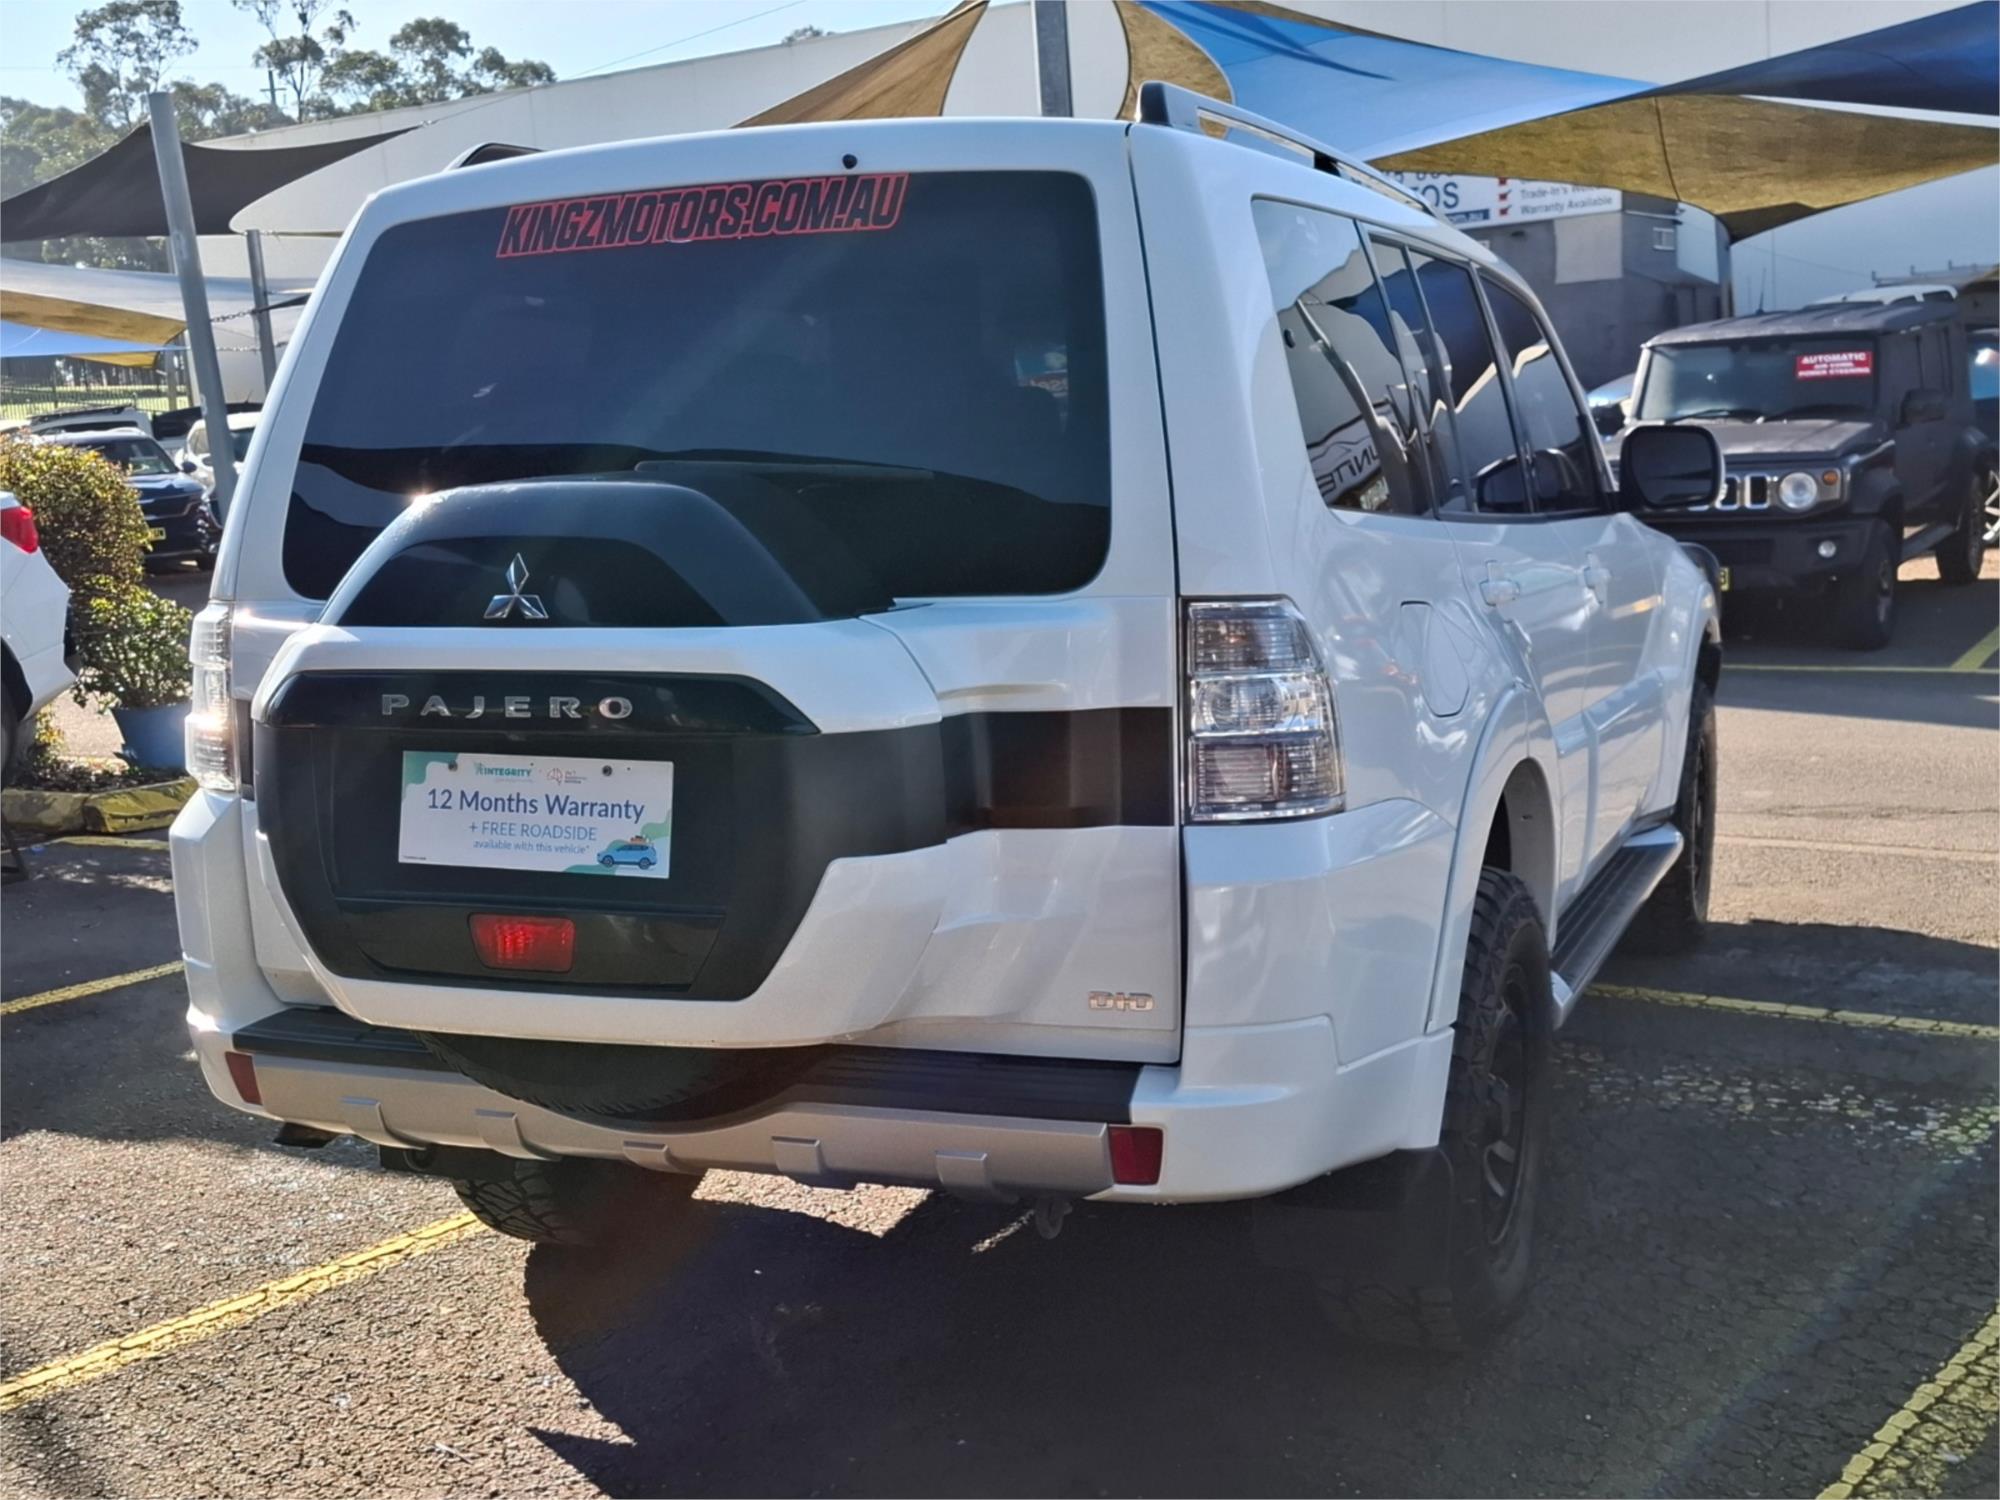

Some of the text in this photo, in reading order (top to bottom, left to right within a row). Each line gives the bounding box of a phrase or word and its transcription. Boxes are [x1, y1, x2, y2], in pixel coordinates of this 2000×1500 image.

[1410, 181, 1460, 209] OS
[1521, 195, 1613, 215] Warranty Available
[1801, 352, 1866, 365] AUTOMATIC
[381, 694, 633, 719] PAJERO
[484, 767, 533, 778] INTEGRITY
[427, 788, 646, 824] 12 Months Warranty
[468, 820, 598, 842] + FREE ROADSIDE
[473, 838, 512, 850] available
[514, 841, 533, 851] with
[534, 842, 552, 852] this
